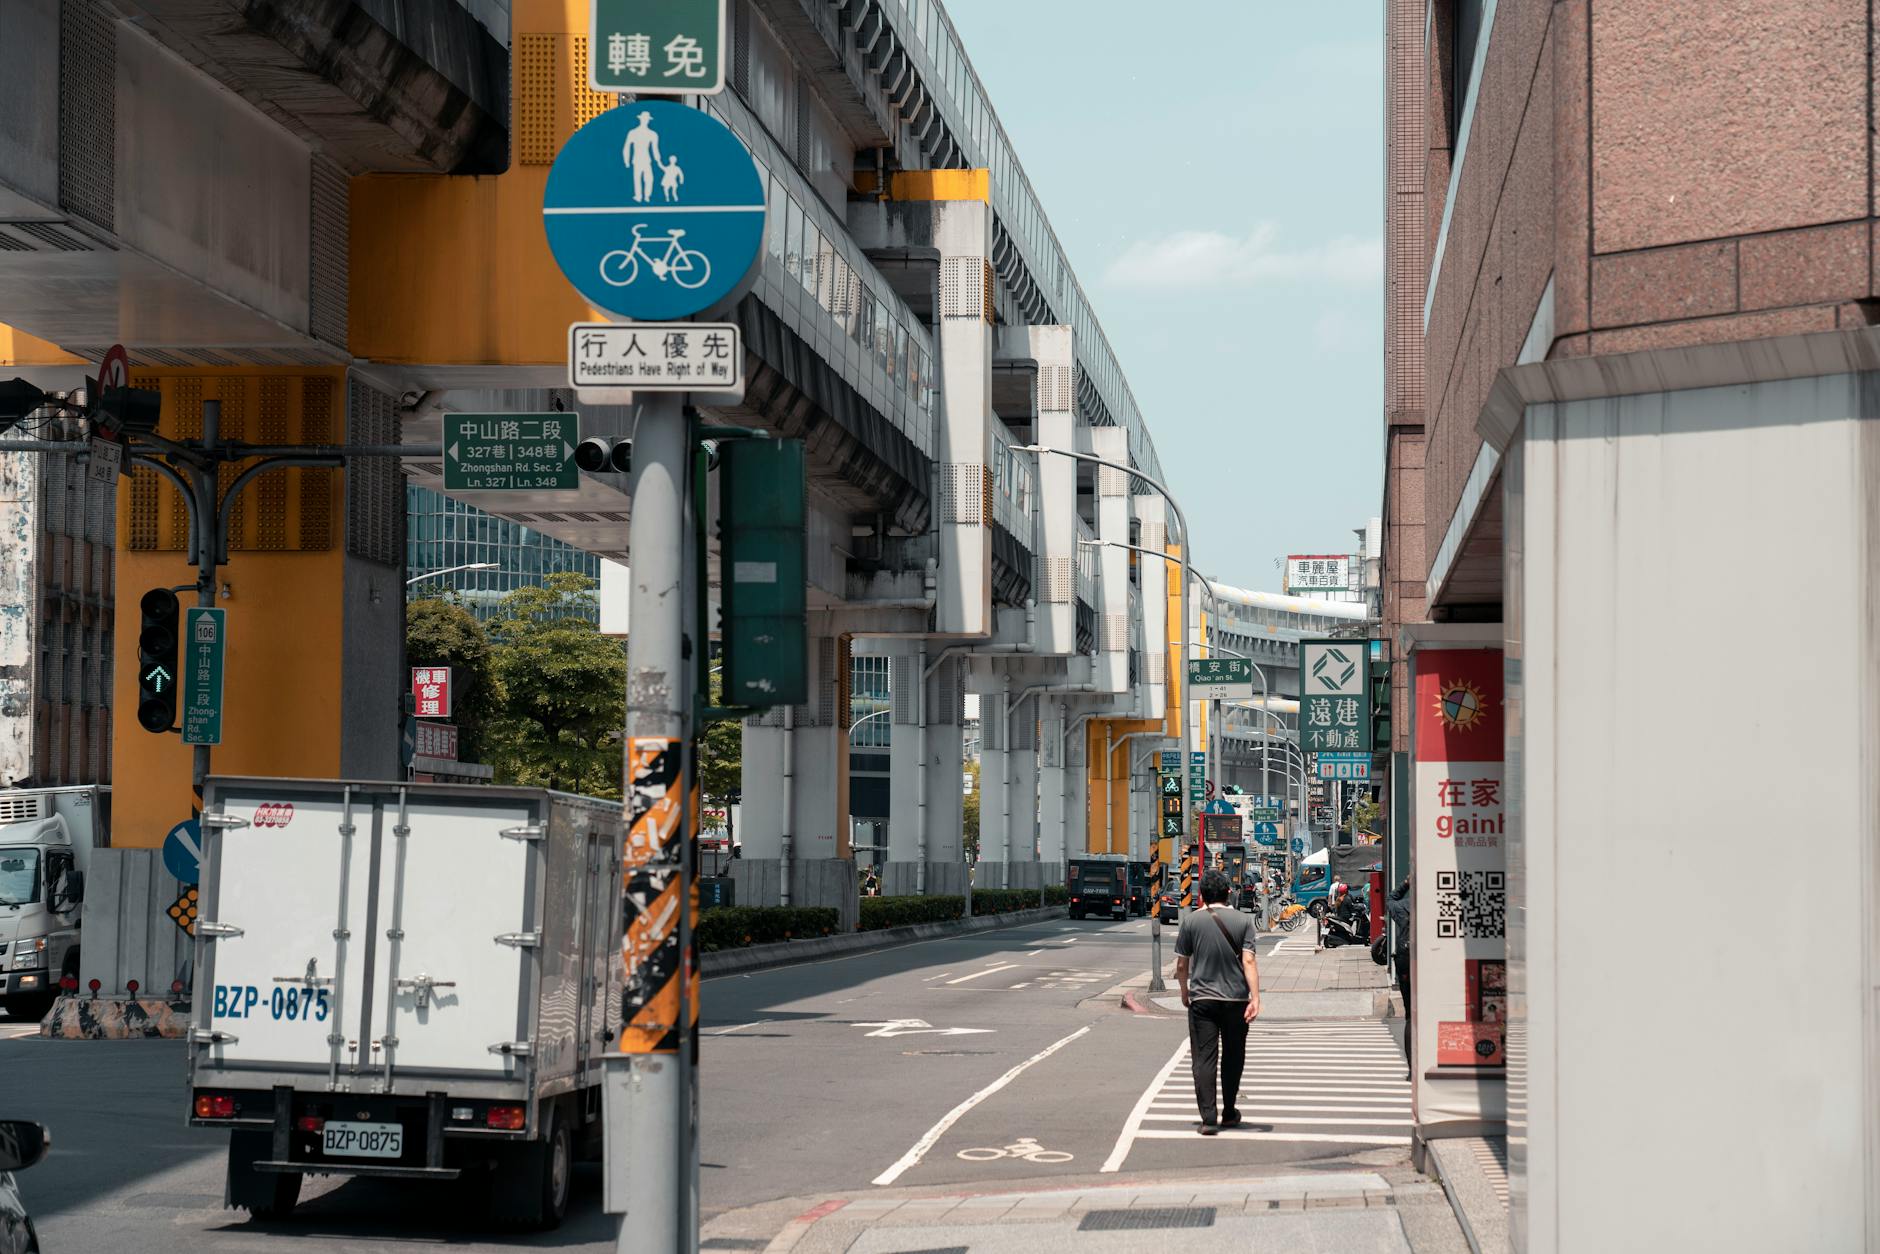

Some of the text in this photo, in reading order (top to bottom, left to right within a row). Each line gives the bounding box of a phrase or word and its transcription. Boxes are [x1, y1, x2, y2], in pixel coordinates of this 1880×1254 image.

[608, 32, 706, 77] 轉免
[580, 332, 730, 358] 行人優先
[580, 361, 729, 380] Pedestrians Have Right of Way
[460, 420, 562, 440] 中山路二段
[467, 444, 558, 459] 327巷 348巷
[460, 462, 563, 475] Zhongshan Rd. Sec. 2
[467, 477, 558, 488] Ln. 327 Ln. 348
[1298, 561, 1339, 574] 車麗屋
[1298, 575, 1339, 586] 汽車百貨
[198, 626, 214, 639] 106
[1189, 661, 1241, 673] 橋安街
[196, 644, 212, 706] 中山路二段
[416, 670, 447, 684] 機車
[421, 685, 440, 699] 修
[188, 706, 218, 718] Zhong-
[421, 701, 440, 715] 理
[1308, 698, 1360, 727] 遠建
[187, 717, 208, 725] shan
[187, 725, 201, 733] Rd.
[187, 734, 214, 743] Sec. 2
[1308, 730, 1360, 749] 不動產
[1438, 778, 1500, 807] 在家
[1169, 798, 1181, 812] 17
[213, 983, 329, 1023] BZP-0875
